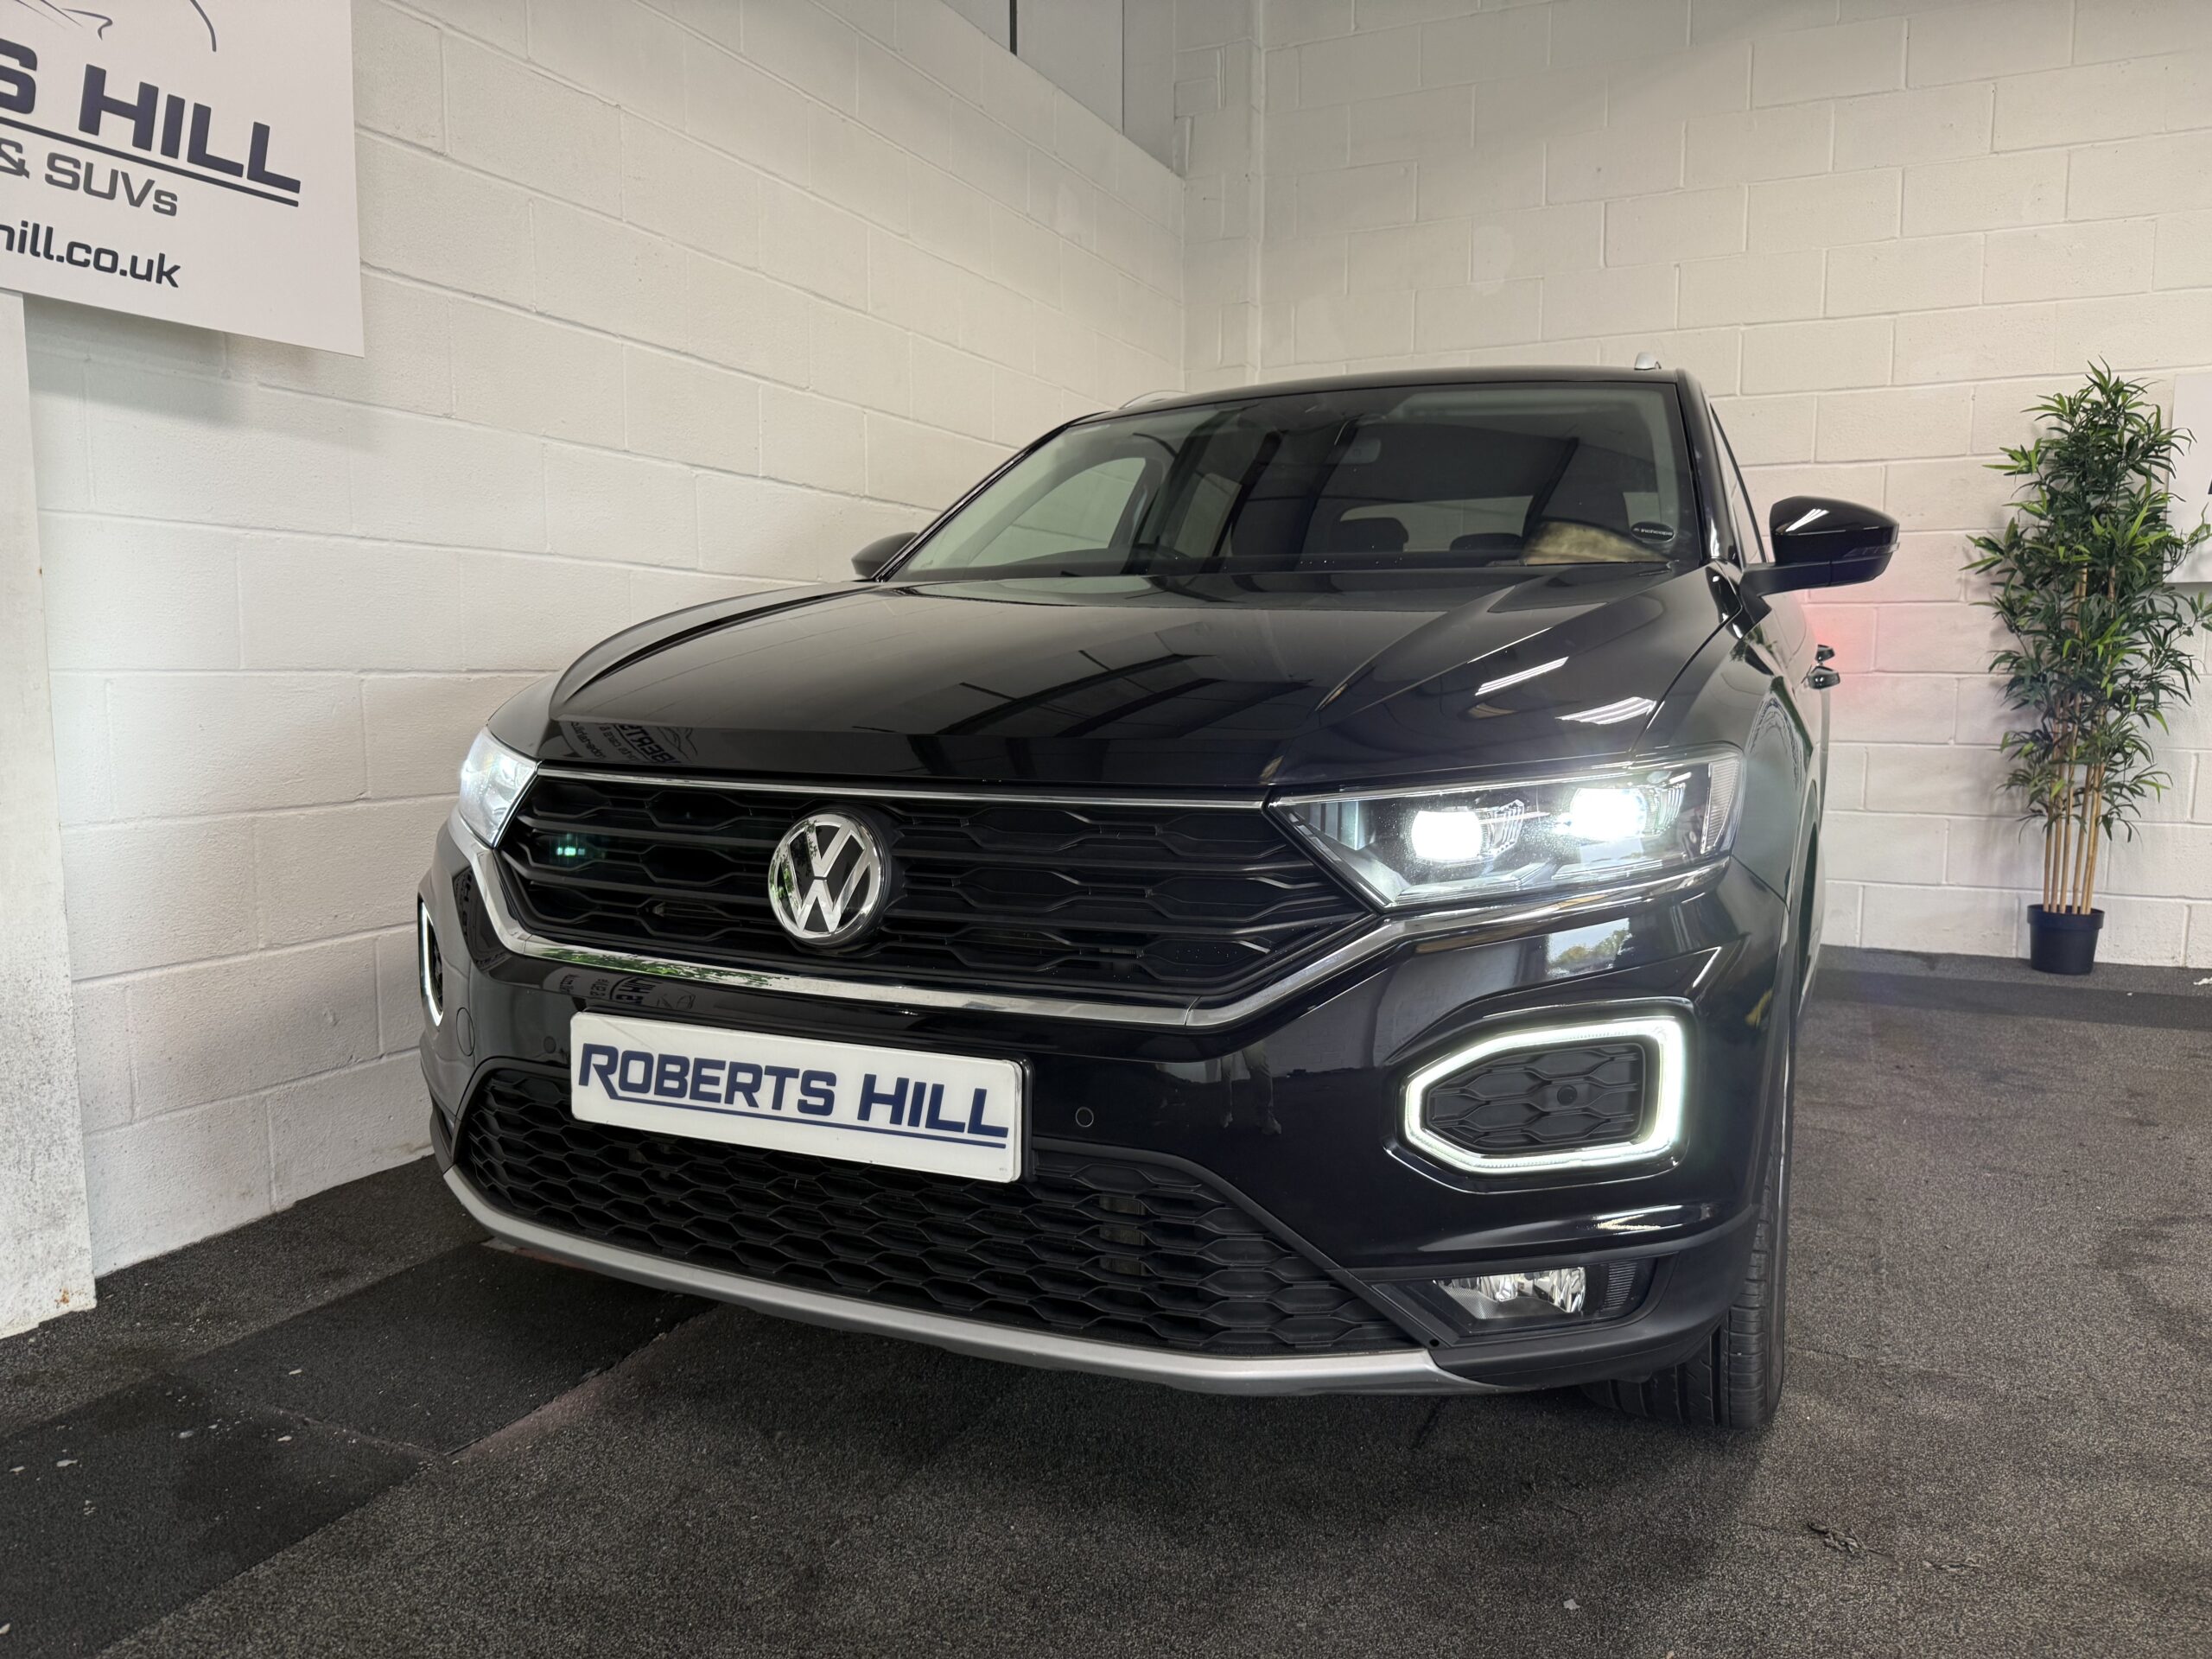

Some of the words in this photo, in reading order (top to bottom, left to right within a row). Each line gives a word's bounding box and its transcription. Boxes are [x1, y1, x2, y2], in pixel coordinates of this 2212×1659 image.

[0, 137, 30, 179] &
[45, 152, 177, 217] SUVs
[79, 64, 302, 194] HILL
[578, 1043, 837, 1116] ROBERTS
[857, 1073, 1009, 1139] HILL
